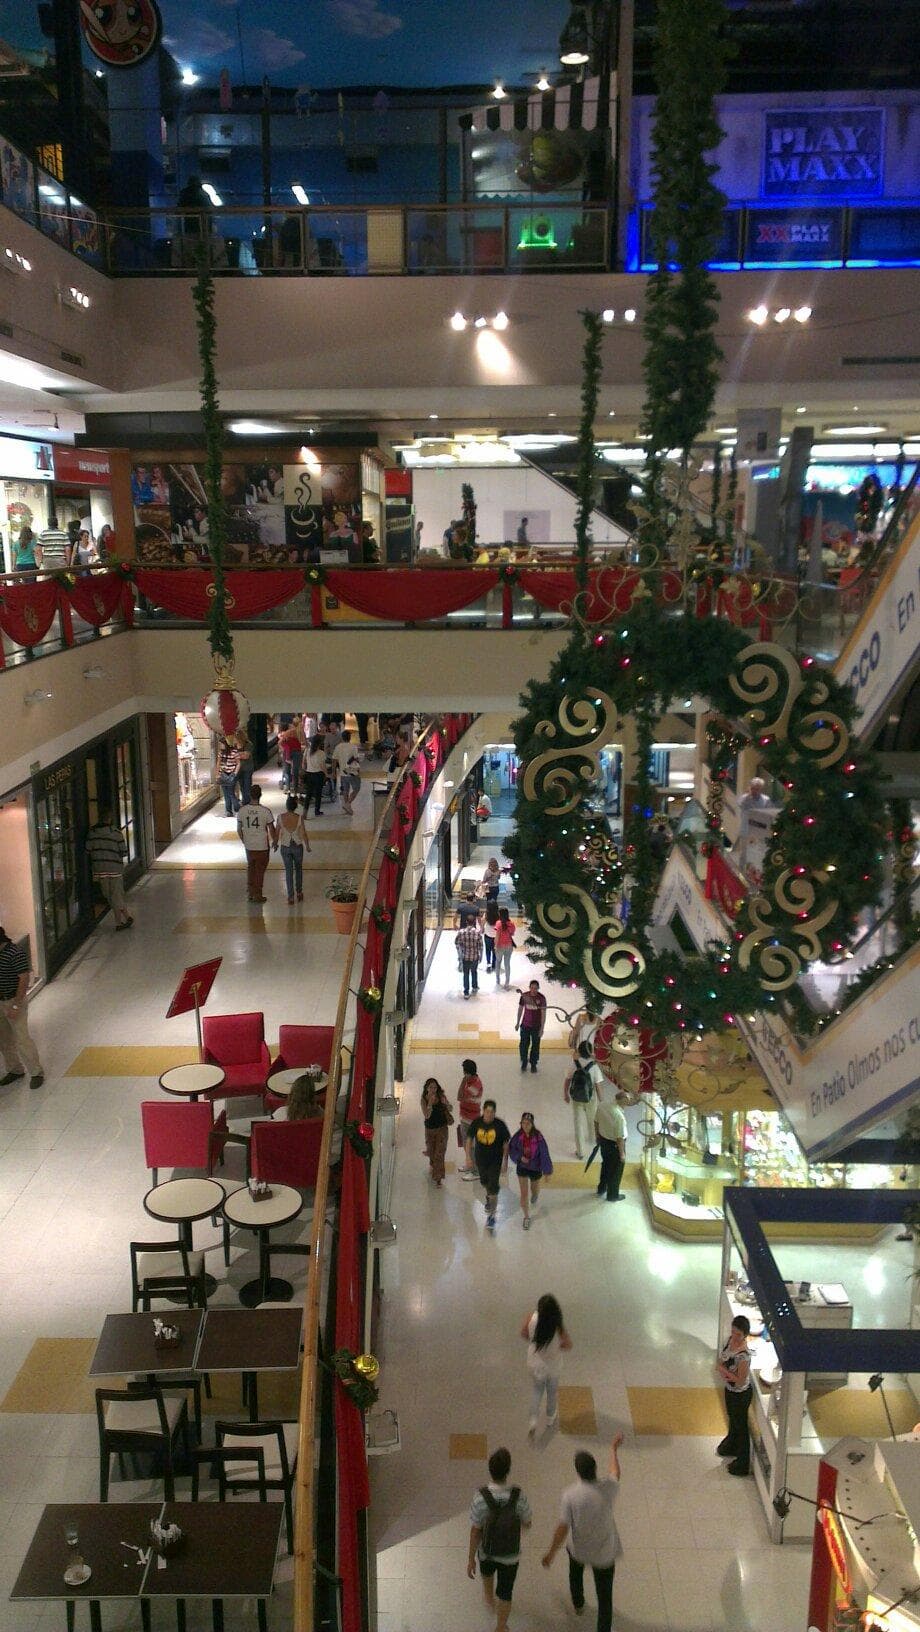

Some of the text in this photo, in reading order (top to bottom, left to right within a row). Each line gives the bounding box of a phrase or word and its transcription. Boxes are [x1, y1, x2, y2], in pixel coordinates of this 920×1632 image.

[771, 126, 865, 153] PLAY
[770, 154, 878, 182] MAXX
[897, 590, 915, 634] En
[246, 816, 260, 829] 14
[810, 1091, 822, 1118] En
[823, 1071, 846, 1109] Patio
[847, 1046, 882, 1089] Olmos
[884, 1028, 906, 1063] nos
